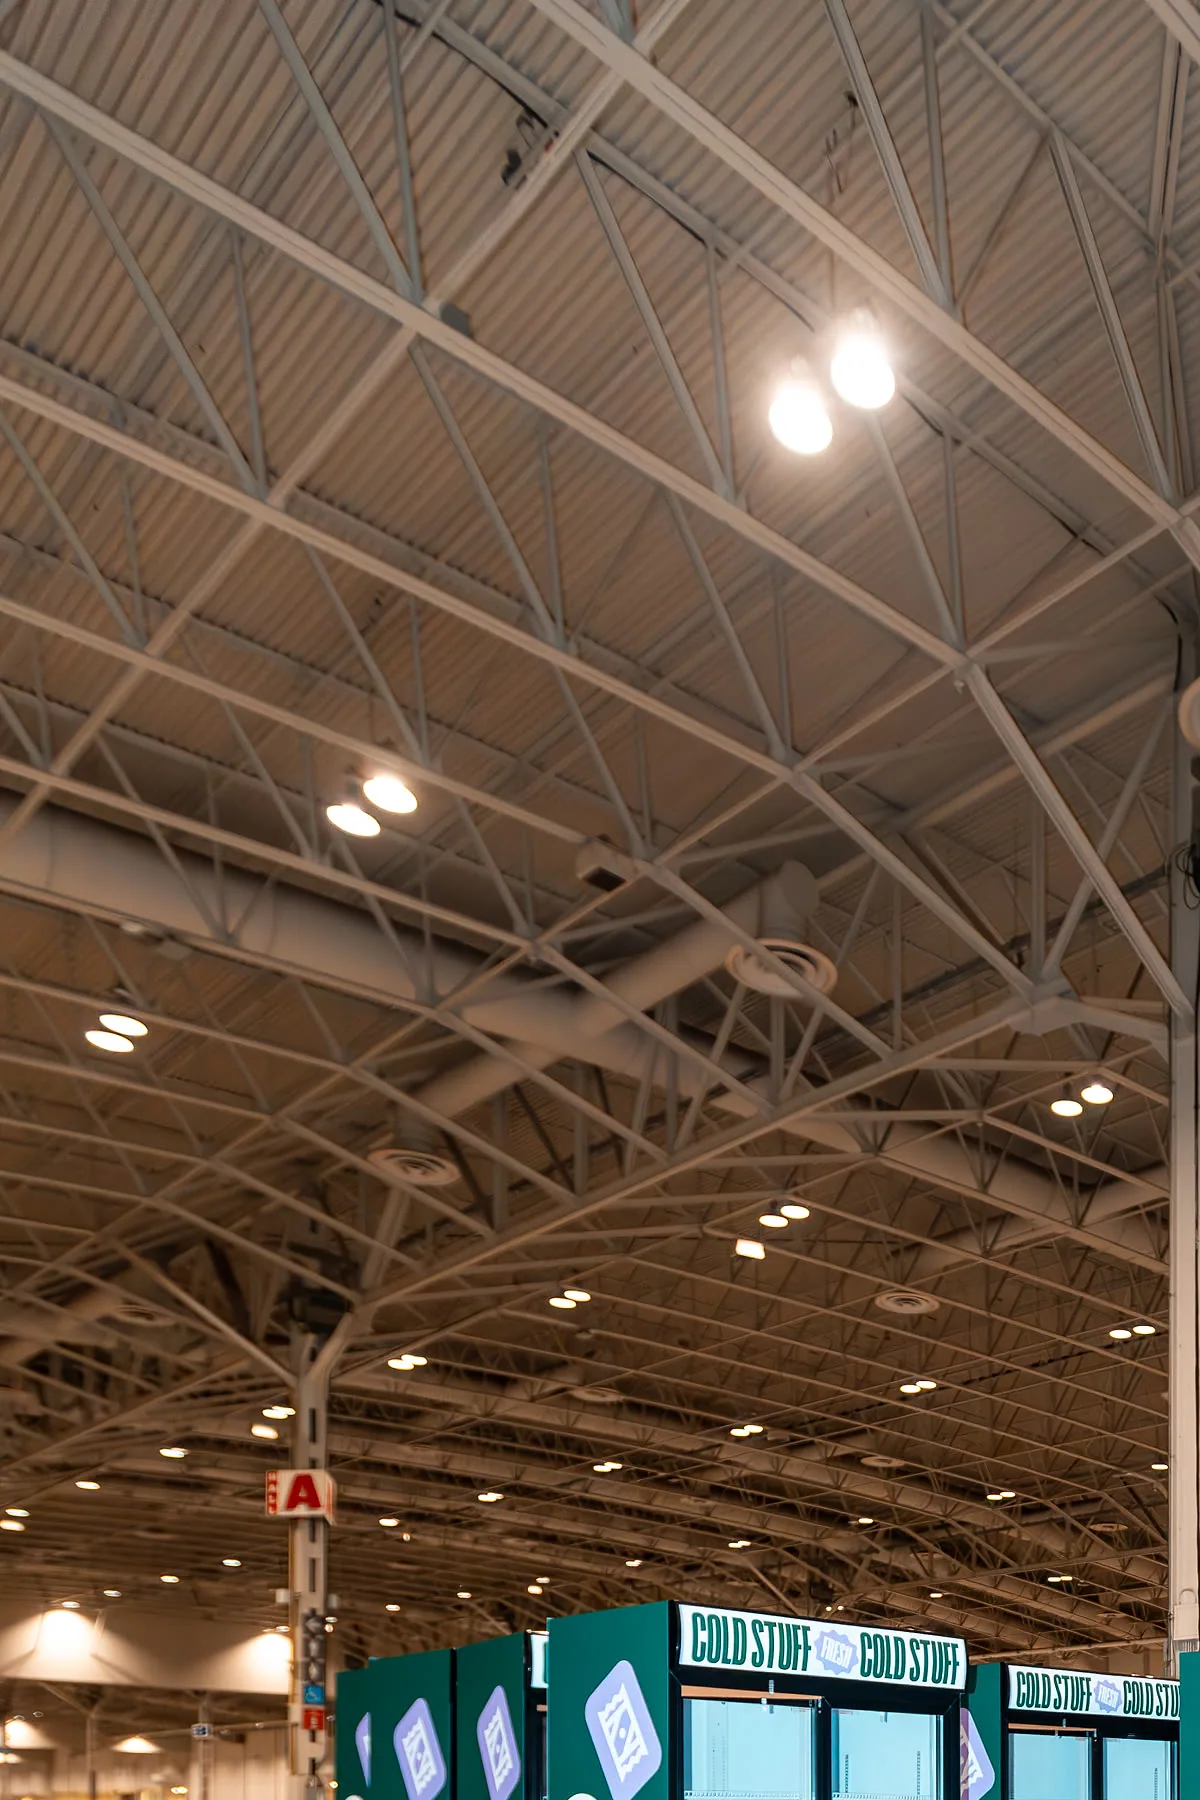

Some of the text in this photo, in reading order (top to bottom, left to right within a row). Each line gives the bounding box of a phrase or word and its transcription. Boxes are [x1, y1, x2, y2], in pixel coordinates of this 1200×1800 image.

[267, 1471, 277, 1515] HALL
[286, 1473, 322, 1511] A
[691, 1611, 812, 1672] COLD STUFF
[820, 1635, 853, 1669] FRESH
[859, 1631, 961, 1686] COLD STUFF
[1016, 1671, 1092, 1712] COLD STUFF
[1123, 1680, 1181, 1718] COLD STU
